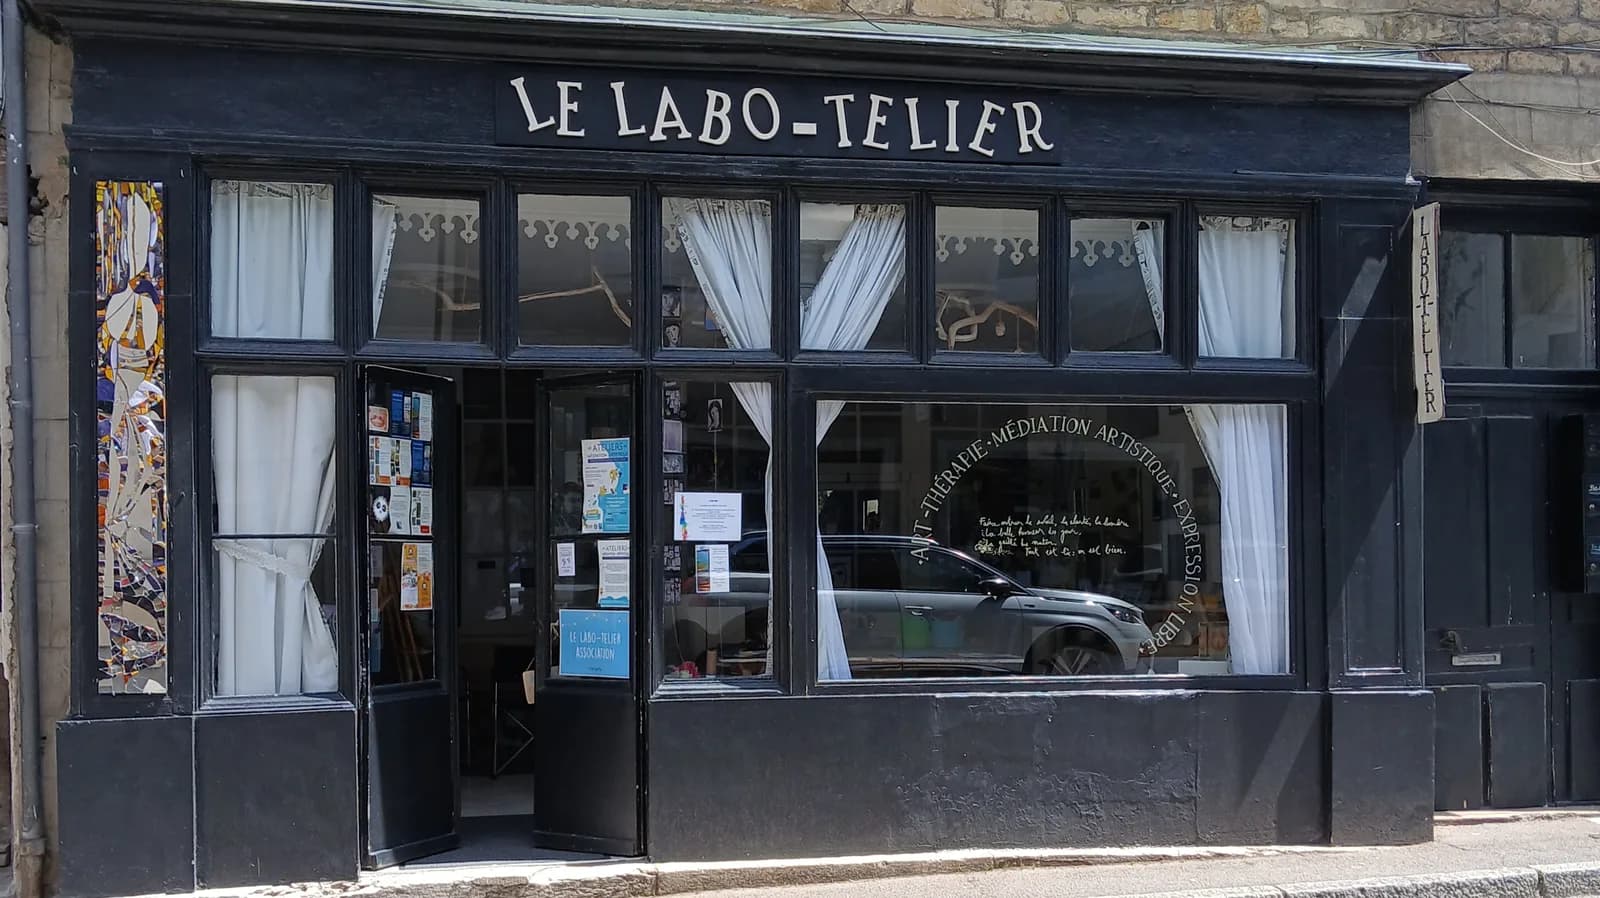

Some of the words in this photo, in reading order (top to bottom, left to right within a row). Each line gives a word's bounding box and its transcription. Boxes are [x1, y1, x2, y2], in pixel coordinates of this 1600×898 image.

[510, 77, 584, 137] LE
[610, 81, 1054, 157] LABO-TELIER
[992, 415, 1092, 447] MÉDIATION
[1095, 425, 1176, 495] ARTISTIQUE
[1173, 499, 1201, 614] EXPRESSION
[569, 631, 577, 643] LE
[579, 631, 622, 645] LABO-TELIER
[575, 645, 616, 662] ASSOCIATION
[1148, 612, 1186, 655] LIBRE
